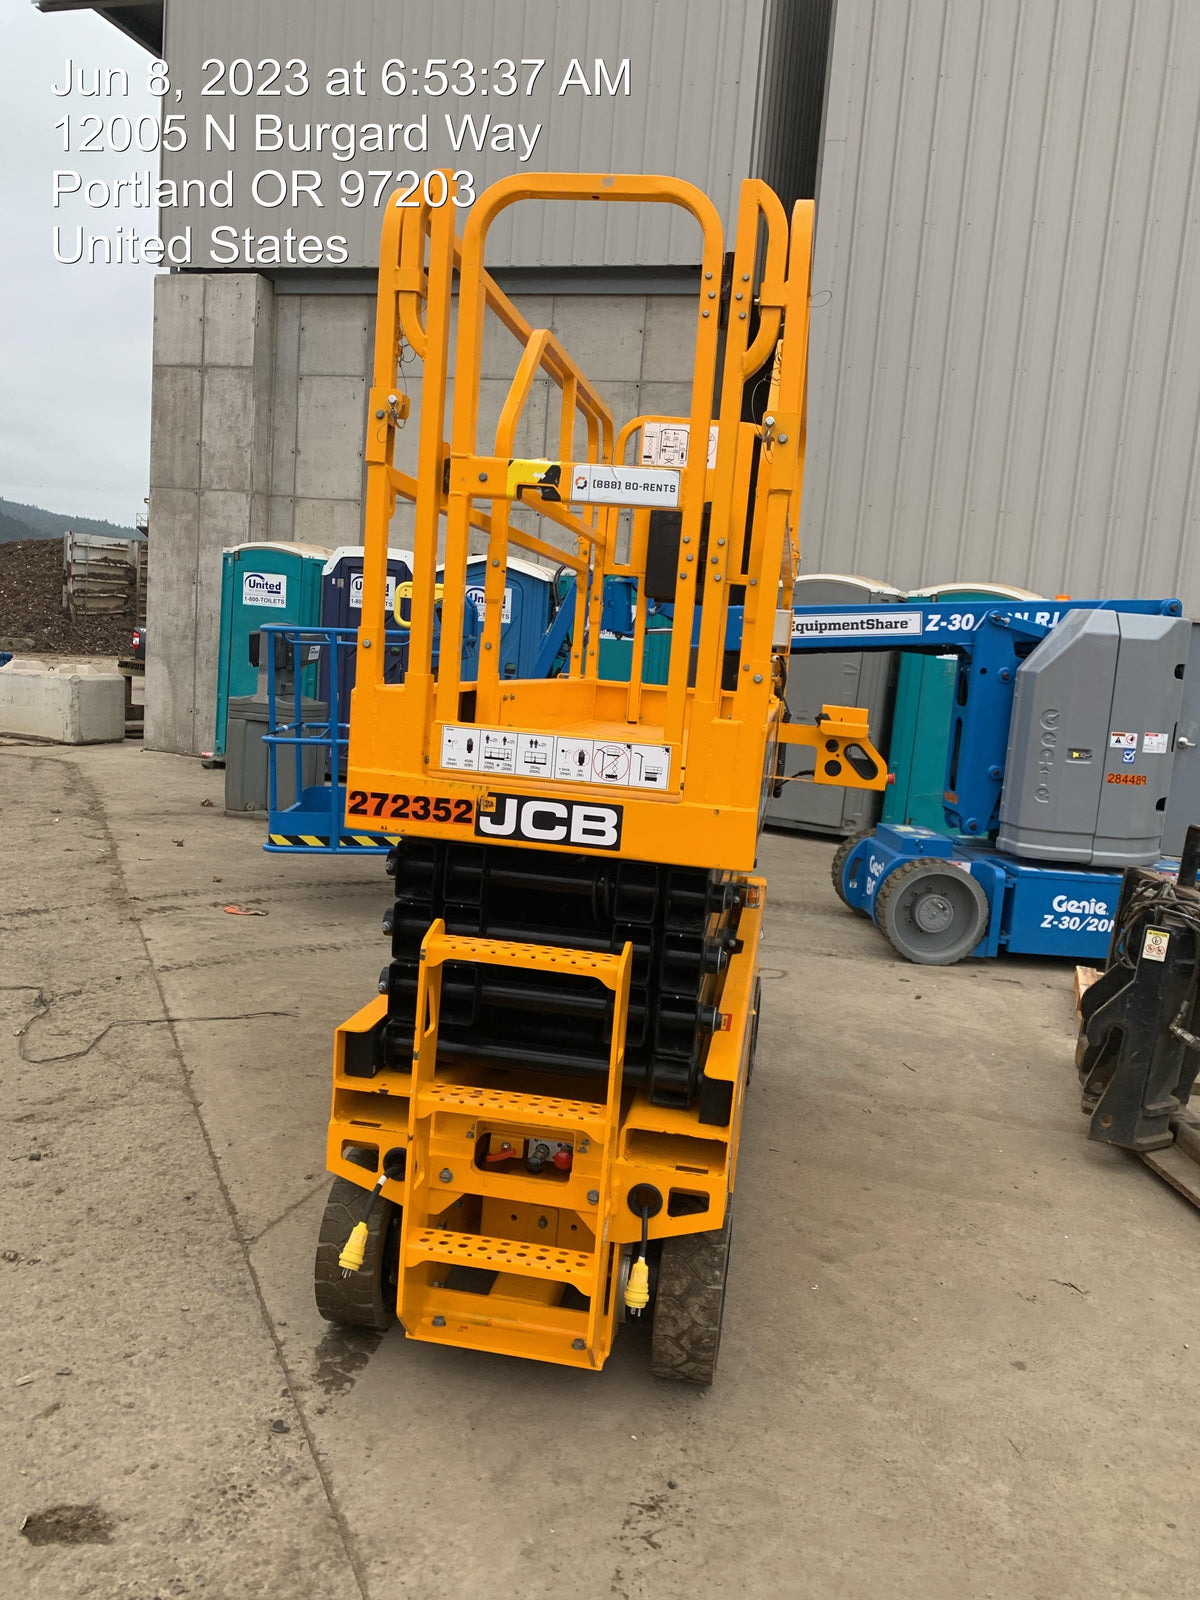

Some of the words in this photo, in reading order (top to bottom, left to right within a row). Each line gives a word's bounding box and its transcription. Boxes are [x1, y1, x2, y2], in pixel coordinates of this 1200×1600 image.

[592, 479, 622, 490] (888)
[625, 481, 676, 493] 80-RENTS
[248, 578, 281, 591] United
[244, 596, 285, 605] 1-800-TOILETS
[1107, 773, 1147, 786] 284489
[348, 791, 473, 824] 272352
[479, 798, 618, 846] JCB
[1052, 895, 1108, 915] Genie
